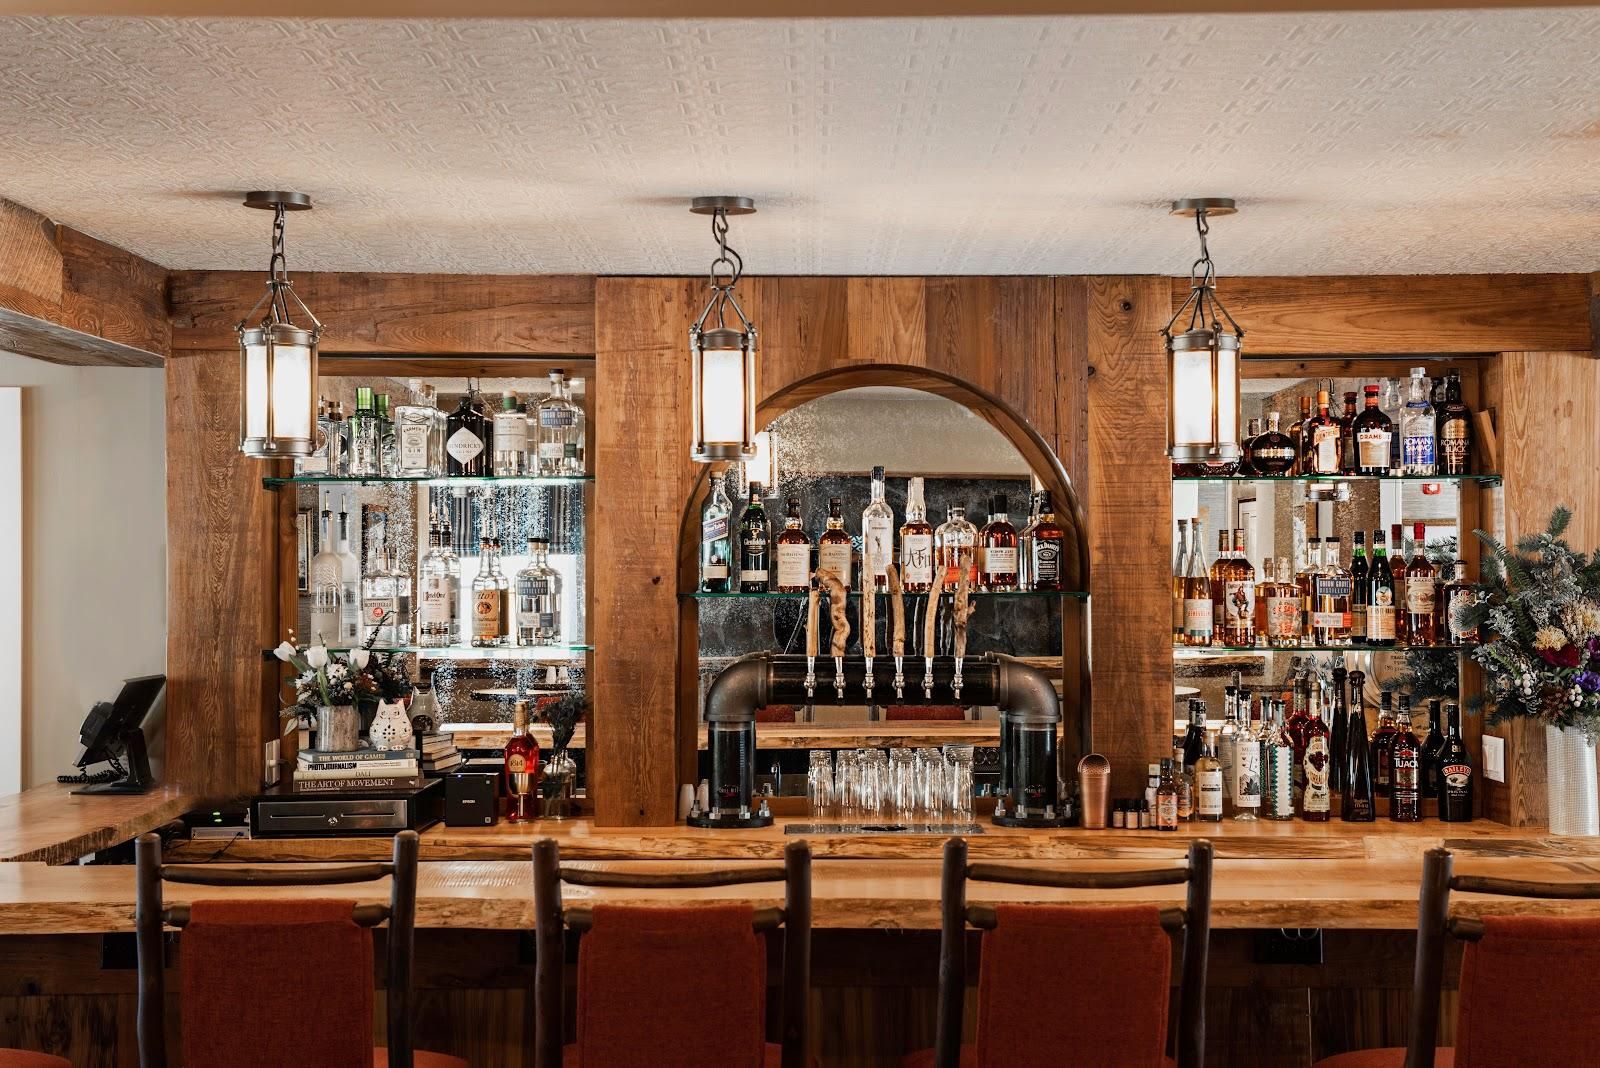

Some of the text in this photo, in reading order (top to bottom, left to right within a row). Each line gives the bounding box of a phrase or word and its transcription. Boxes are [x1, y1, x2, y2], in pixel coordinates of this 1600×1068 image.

[1441, 438, 1470, 446] ROMANA
[307, 762, 357, 771] PHOTOJOURNALISM
[1393, 757, 1419, 768] TUACA
[1443, 766, 1471, 774] BAILEYS
[298, 781, 316, 789] THE
[317, 780, 333, 788] ART
[346, 778, 395, 787] MOVEMENT
